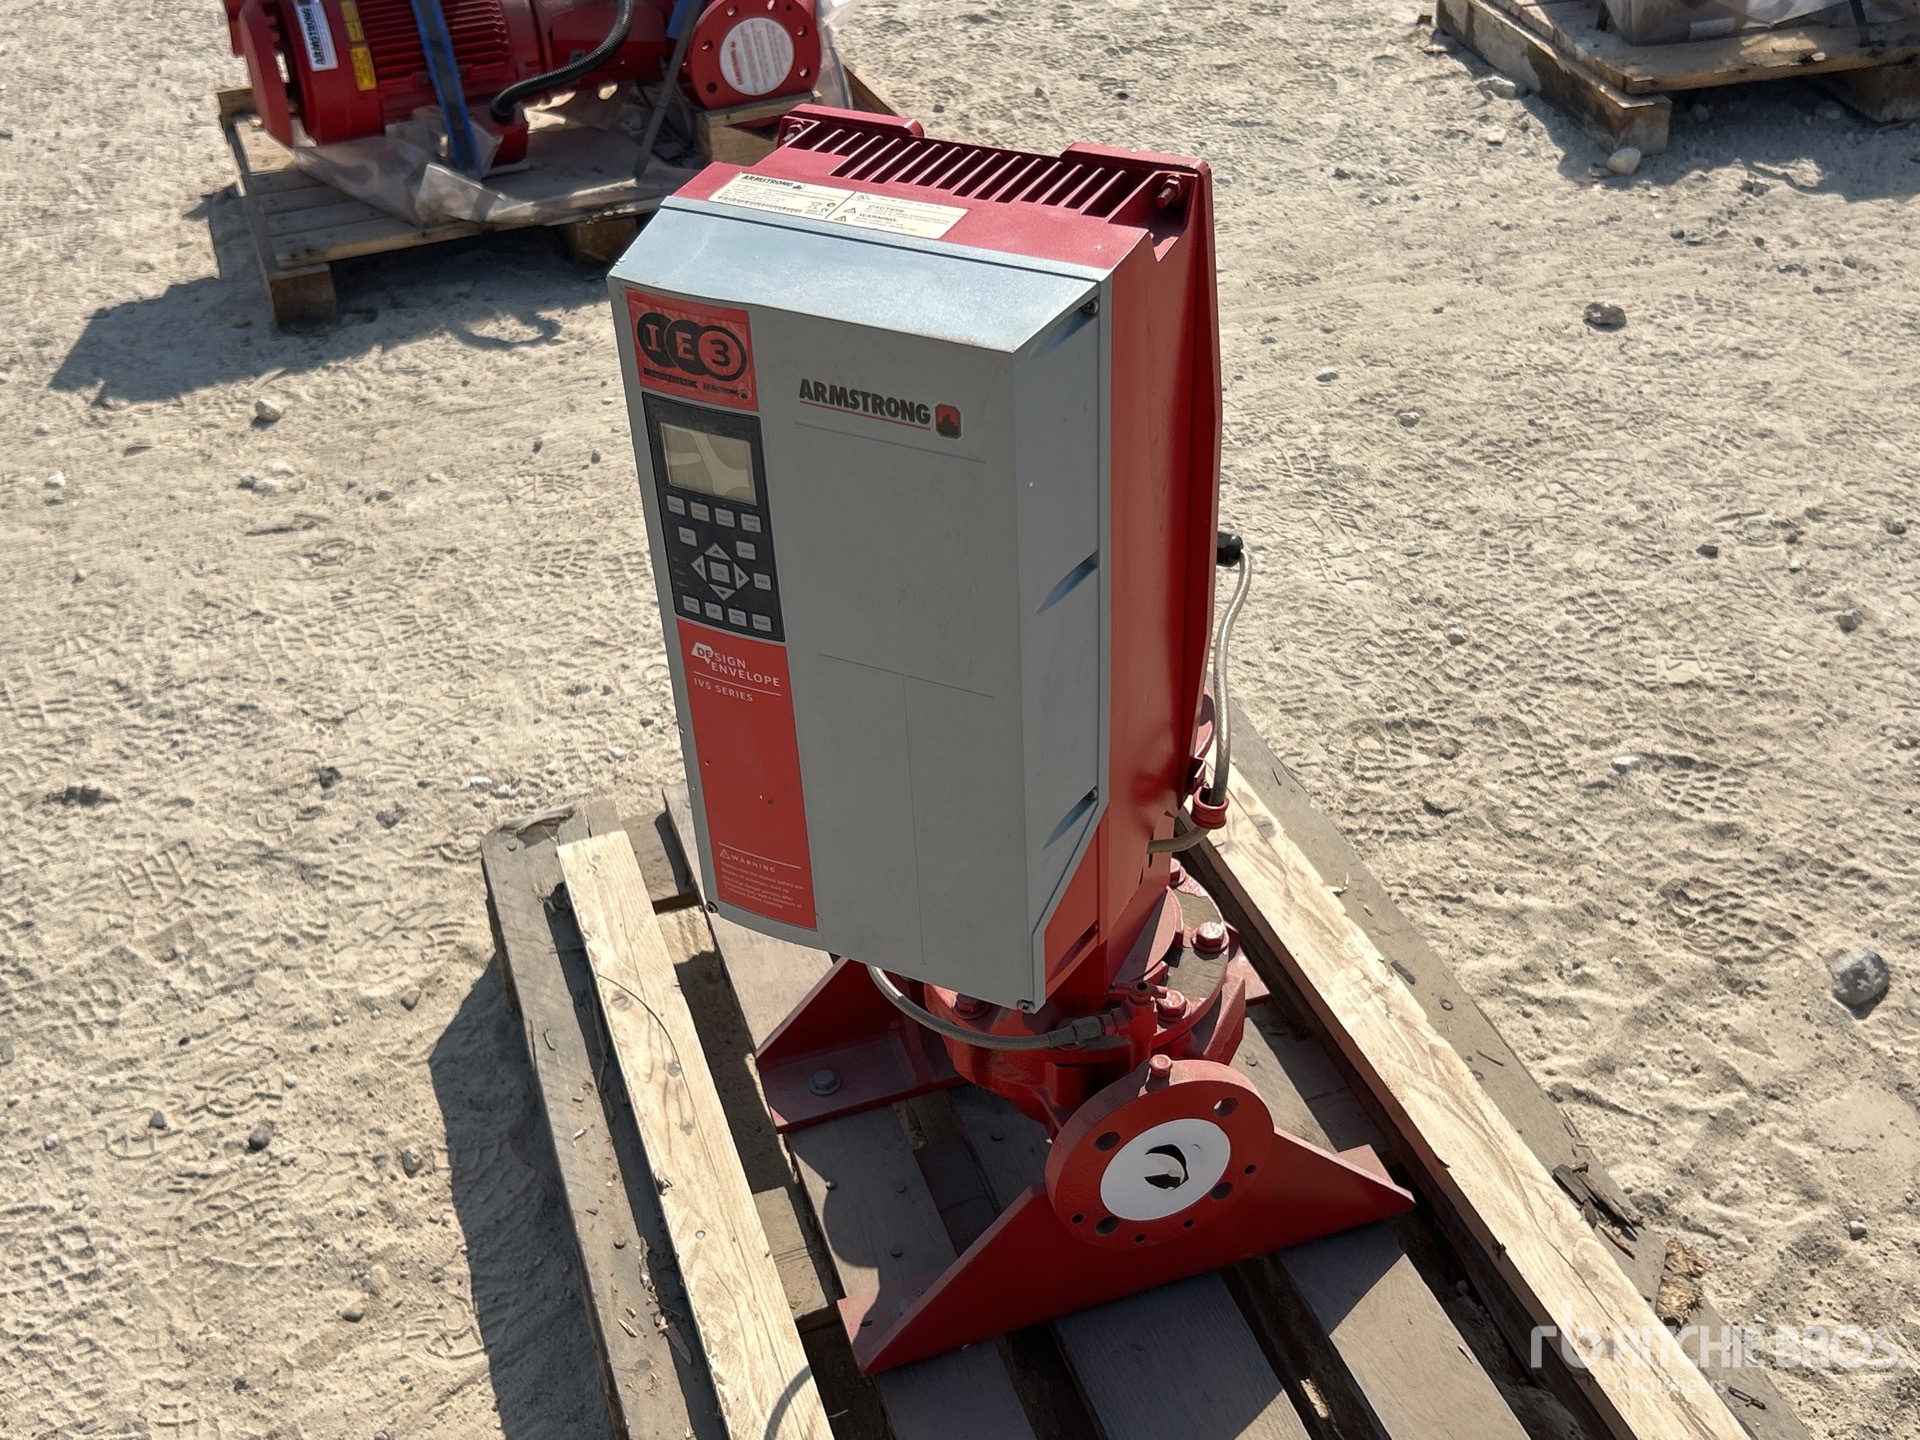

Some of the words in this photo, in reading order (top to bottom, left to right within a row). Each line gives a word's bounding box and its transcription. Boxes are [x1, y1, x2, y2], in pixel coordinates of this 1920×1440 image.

[742, 174, 794, 188] ARMSTRONG
[799, 378, 931, 425] ARMSTRONG
[697, 646, 746, 669] DESIGN
[711, 662, 780, 688] ENVELOPE
[694, 677, 712, 690] IVS
[715, 684, 754, 703] SERIES
[731, 854, 776, 873] WARNING
